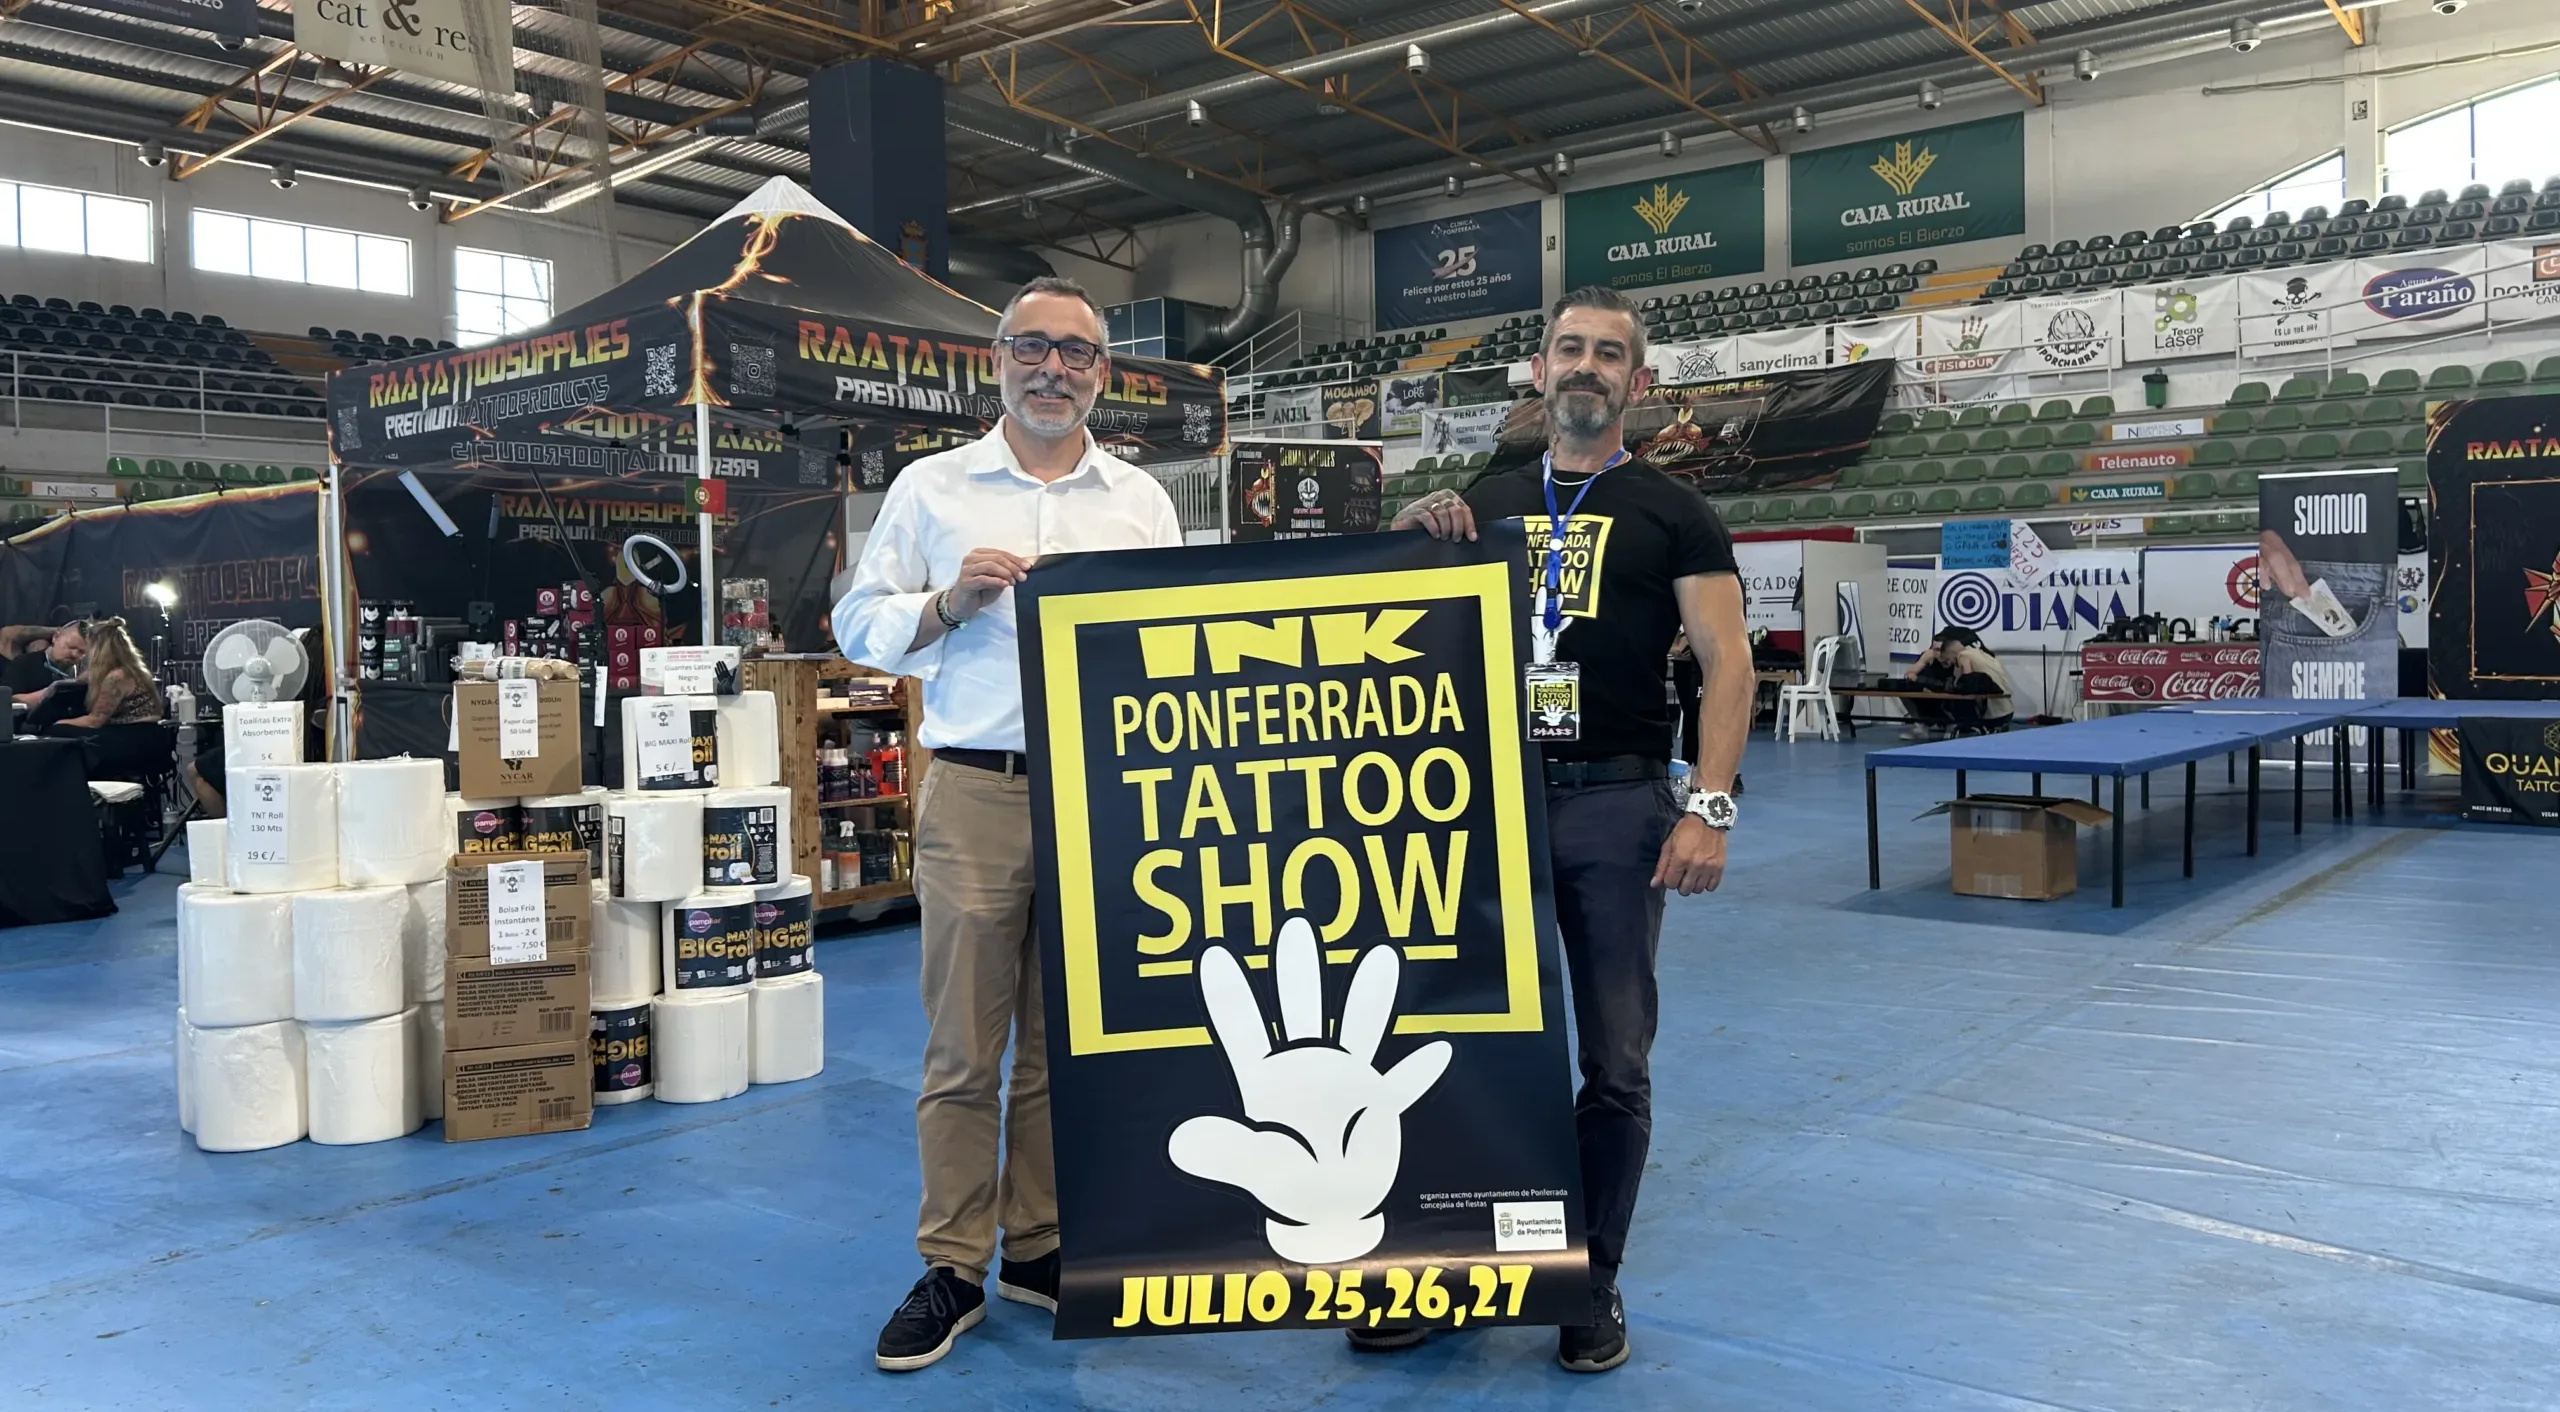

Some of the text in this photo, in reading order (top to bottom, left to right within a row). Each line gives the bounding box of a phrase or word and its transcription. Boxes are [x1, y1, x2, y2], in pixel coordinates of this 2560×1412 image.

[360, 34, 444, 60] selección
[1840, 191, 1970, 227] CAJA RURAL
[1607, 232, 1717, 262] CAJA RURAL
[1847, 226, 1965, 252] somos El Bierzo
[1437, 245, 1477, 280] 25
[1612, 263, 1712, 287] somos El Bierzo
[1403, 273, 1512, 298] Felices por estos 25 años
[1432, 292, 1467, 303] vuestro
[1467, 287, 1488, 298] lado
[2380, 282, 2472, 309] Paraño
[2171, 327, 2204, 336] Tecno
[2155, 332, 2204, 349] Láser
[369, 319, 631, 411] RAATATTOOSUPPLIES
[1739, 353, 1818, 373] sanyclima
[1934, 356, 1994, 372] FISIODUR
[1324, 383, 1378, 400] MOGAMBO
[1453, 408, 1499, 420] PEÑA C. D.
[1280, 447, 1307, 467] GERMAN
[2098, 454, 2176, 470] Telenauto
[2090, 486, 2162, 499] CAJA RURAL
[2293, 492, 2368, 537] SUMUN
[1902, 578, 1929, 594] CON
[2002, 589, 2129, 632] DIANA
[1138, 608, 1429, 680] INK
[665, 664, 692, 672] Guantes
[2291, 660, 2365, 700] SIEMPRE
[239, 716, 291, 725] Toallitas Extra
[1113, 672, 1465, 757] PONFERRADA
[242, 729, 289, 737] Absorbentes
[658, 738, 678, 746] MAXI
[1122, 747, 1471, 841] TATTOO
[464, 836, 509, 853] BIG
[538, 831, 572, 842] MAXI
[709, 833, 742, 844] MAXI
[248, 851, 267, 860] 19 €
[709, 843, 742, 860] roll
[1132, 831, 1469, 955] SHOW
[498, 906, 519, 914] Bolsa
[495, 916, 540, 925] Instantánea
[522, 941, 538, 949] 7,50
[540, 940, 545, 948] €
[754, 928, 789, 950] BIG
[679, 937, 726, 959] BIG
[608, 1035, 648, 1061] BIG
[1420, 1192, 1449, 1201] organiza
[1474, 1190, 1520, 1201] ayuntamiento
[1466, 1200, 1487, 1208] fiestas
[1516, 1218, 1562, 1227] Ayuntamiento
[1527, 1228, 1563, 1236] Ponferrada
[1113, 1265, 1534, 1328] JULIO 25,26,27
